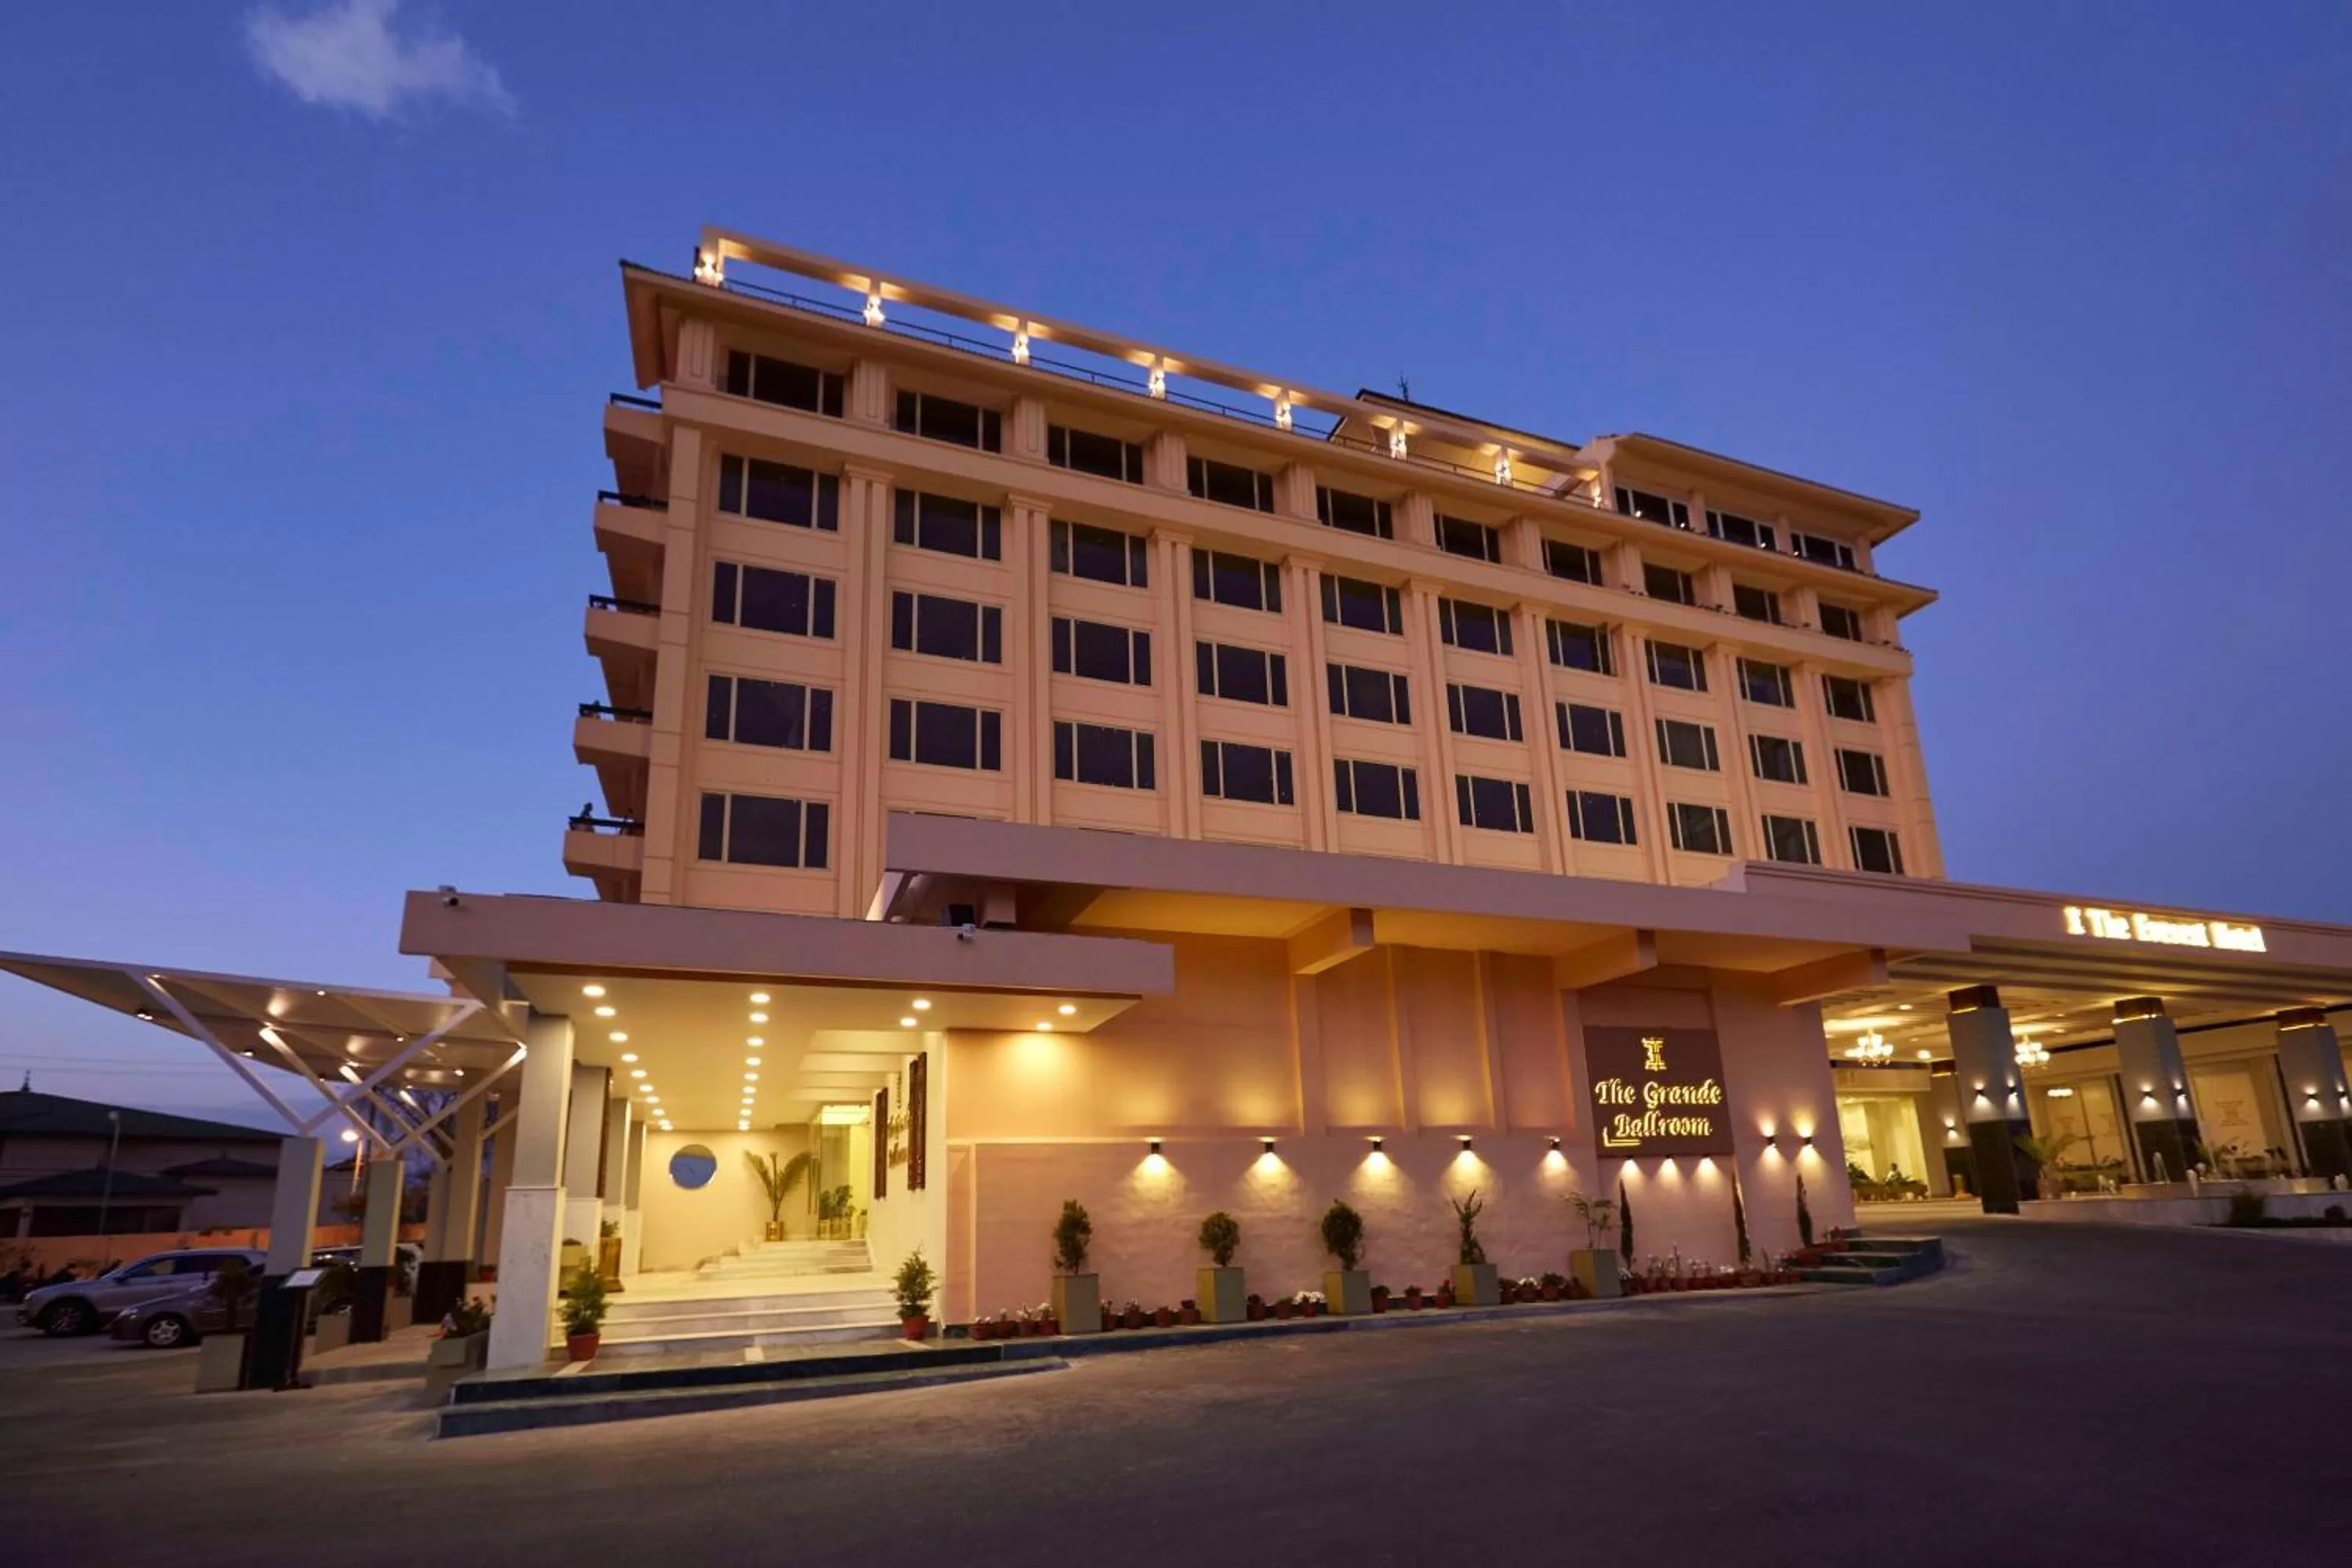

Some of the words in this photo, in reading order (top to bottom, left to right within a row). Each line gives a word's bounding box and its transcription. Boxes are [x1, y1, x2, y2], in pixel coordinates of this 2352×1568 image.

[1595, 1078, 1636, 1105] The
[1643, 1078, 1722, 1109] Grande
[1613, 1110, 1713, 1138] Ballroom
